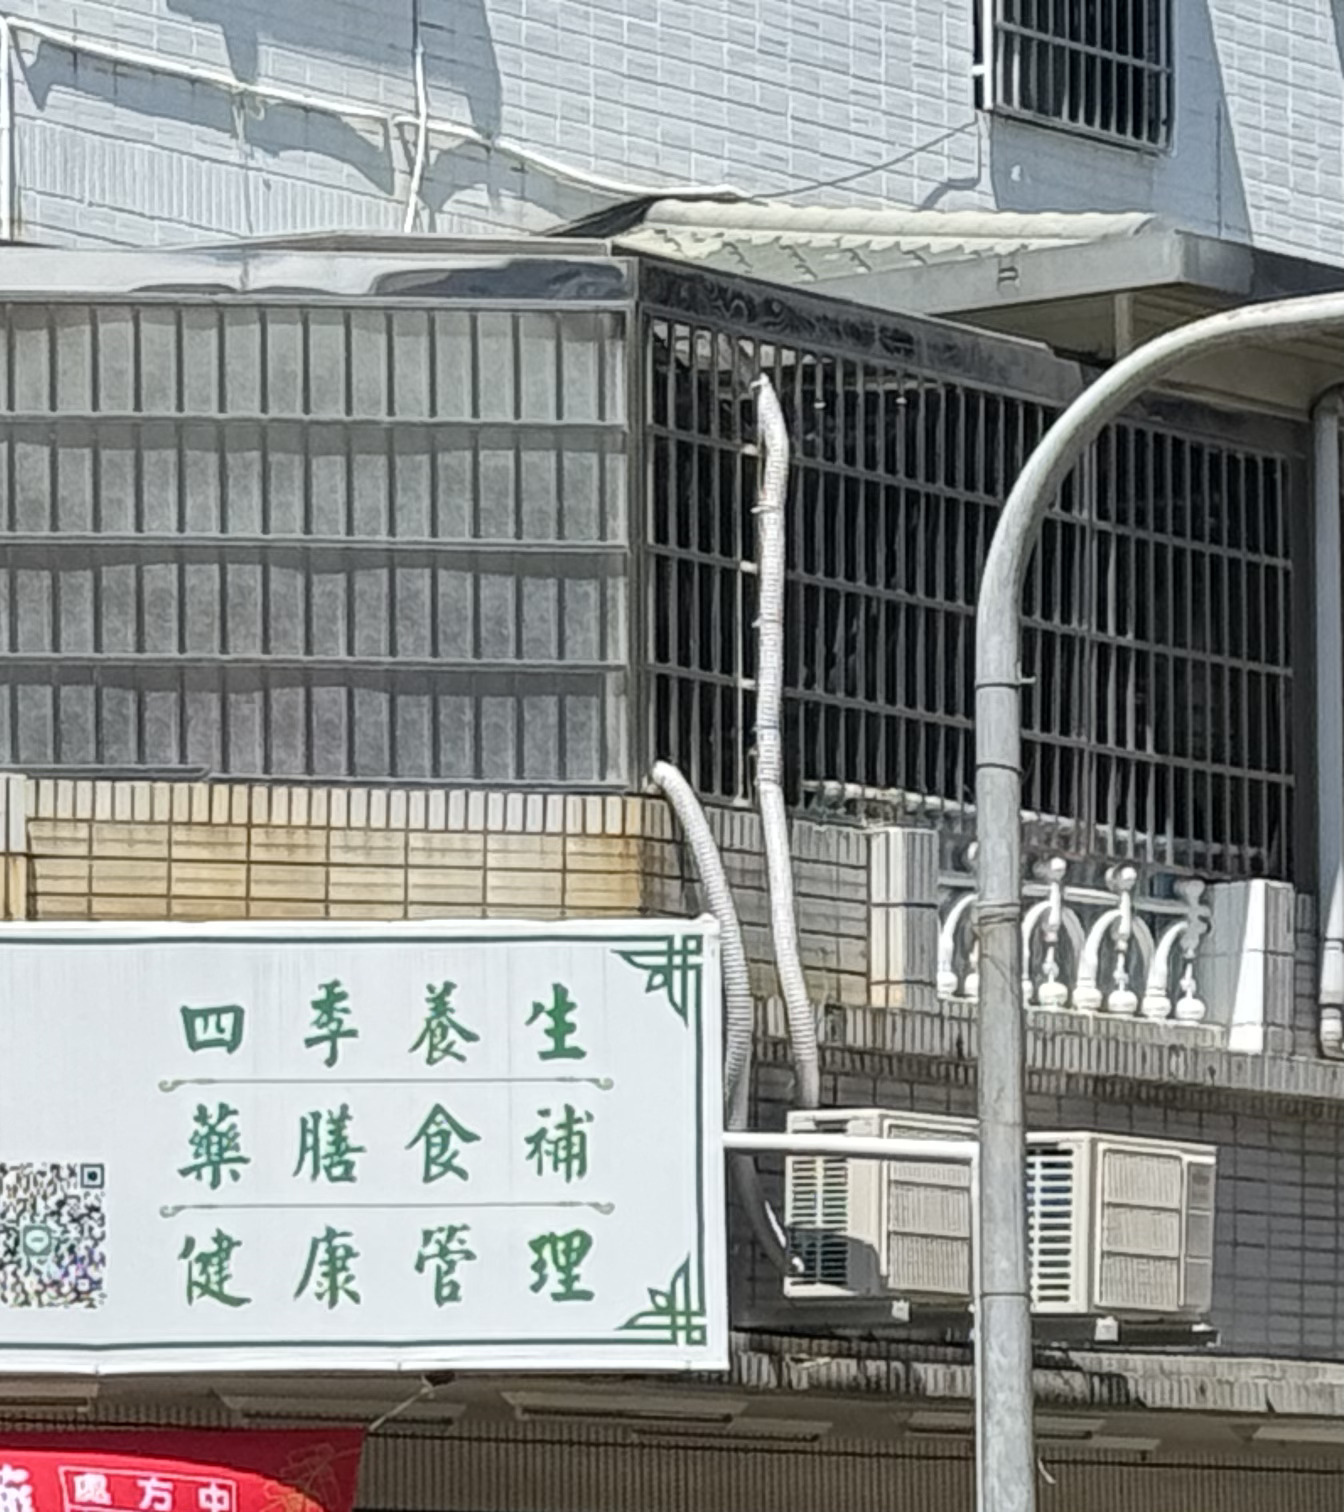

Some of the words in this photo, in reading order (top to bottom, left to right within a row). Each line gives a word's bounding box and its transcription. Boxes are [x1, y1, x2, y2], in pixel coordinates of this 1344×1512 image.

[178, 979, 589, 1067] 四季養生
[176, 1102, 595, 1190] 藥膳食補
[177, 1223, 596, 1307] 健康管理
